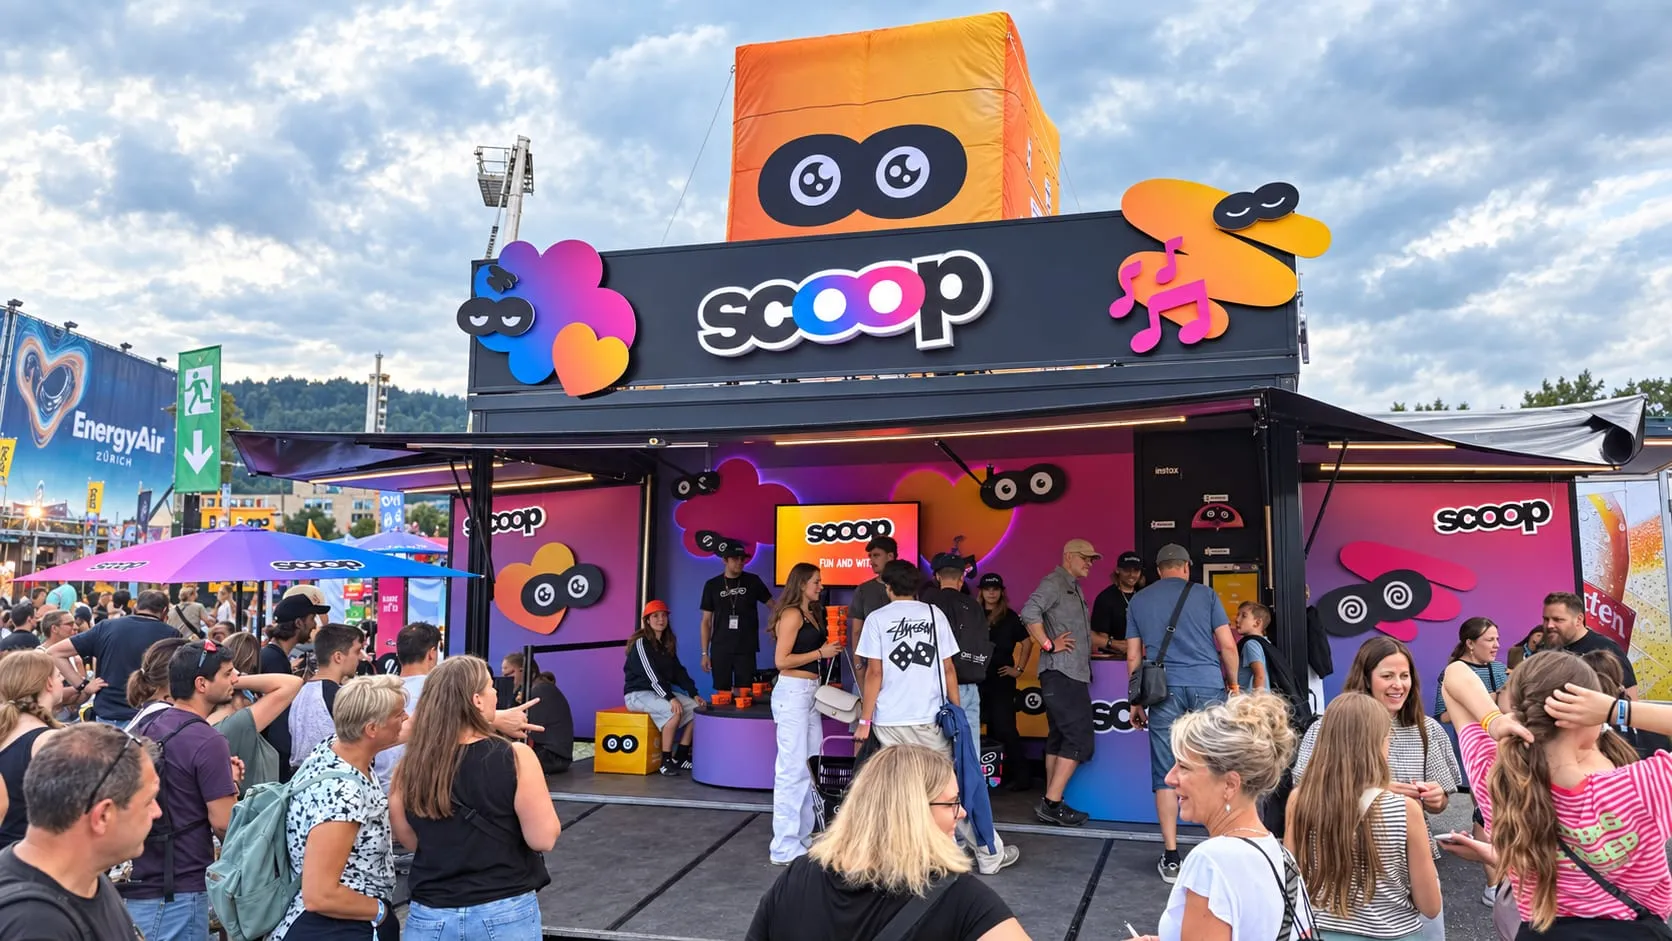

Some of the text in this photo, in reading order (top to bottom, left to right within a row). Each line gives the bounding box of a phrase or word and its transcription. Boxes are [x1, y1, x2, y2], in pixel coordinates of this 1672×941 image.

[697, 250, 994, 357] scoop
[72, 410, 165, 455] EnergyAir
[96, 450, 132, 467] ZÜRICH
[1433, 498, 1553, 535] scoop
[819, 558, 834, 568] FUN
[836, 558, 853, 568] AND
